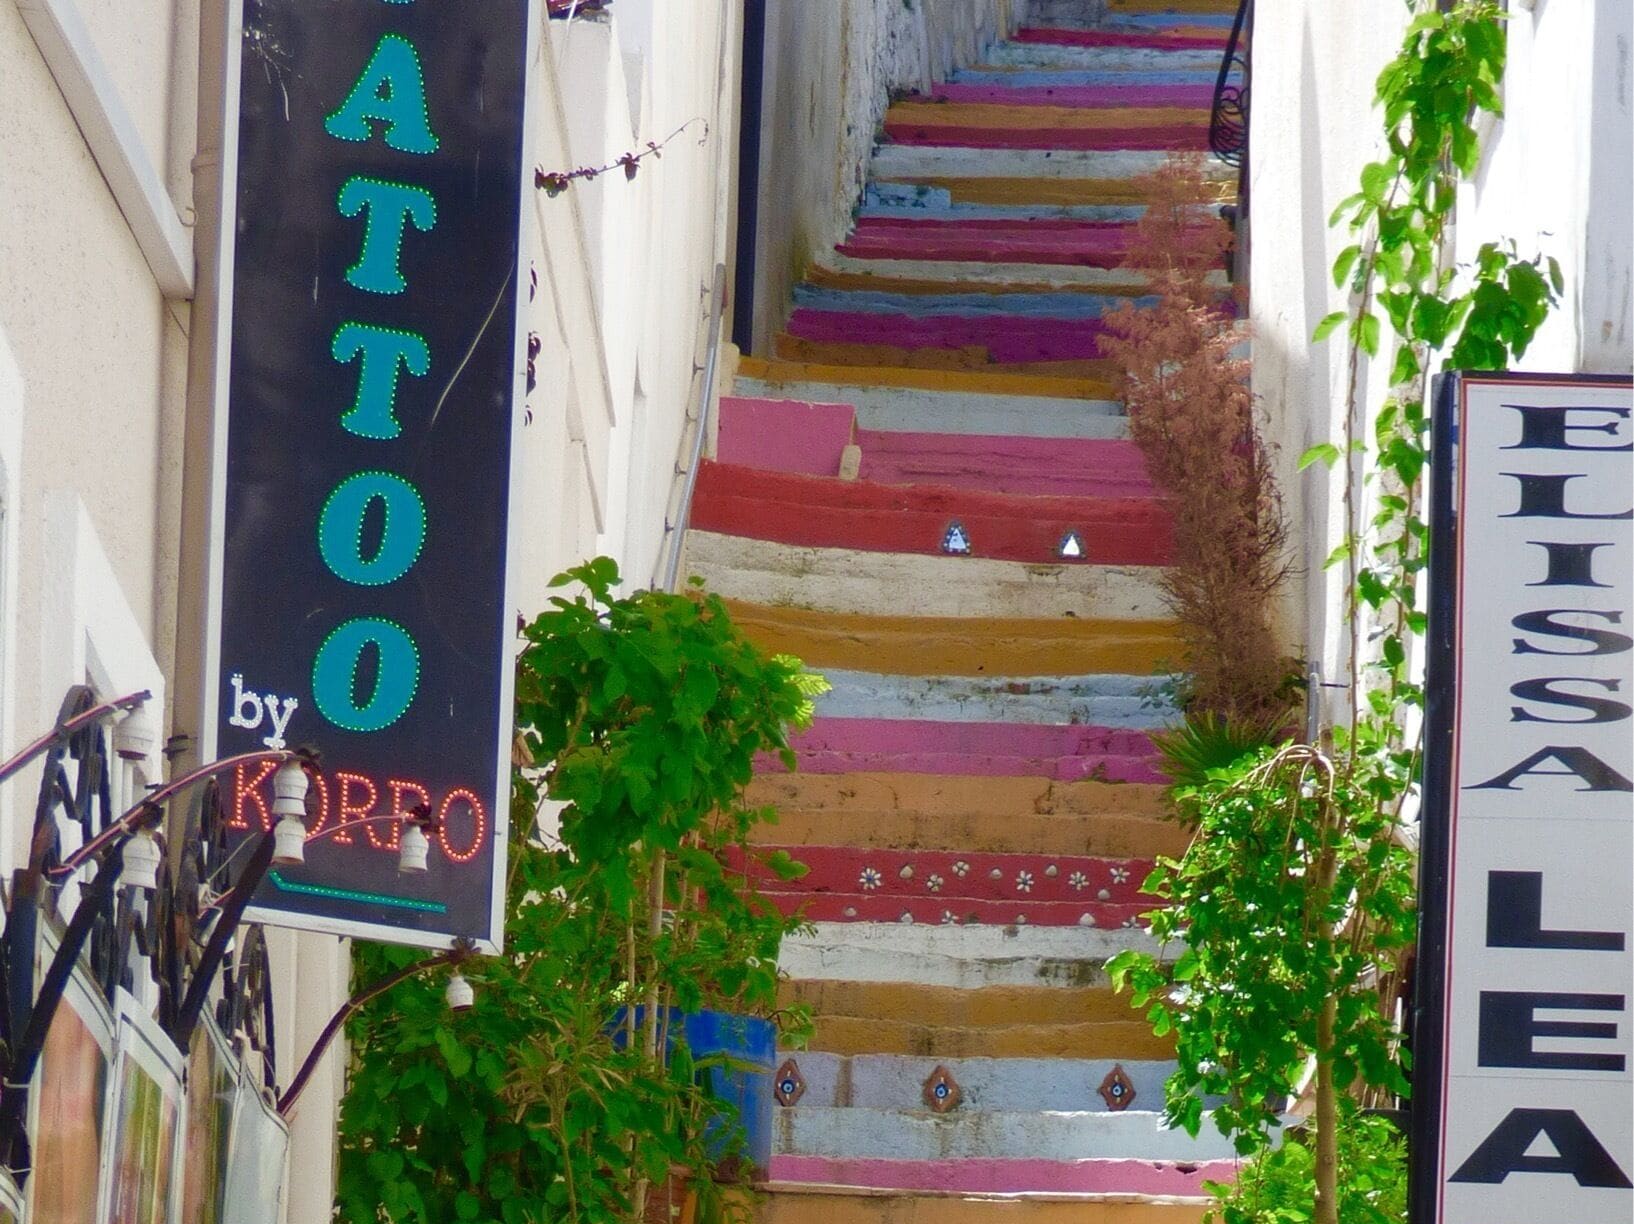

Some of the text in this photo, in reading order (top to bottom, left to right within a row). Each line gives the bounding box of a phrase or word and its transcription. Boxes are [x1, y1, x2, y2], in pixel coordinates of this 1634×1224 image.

[313, 0, 440, 731] ATTOO
[229, 673, 298, 749] by
[1461, 404, 1633, 792] ELISSA
